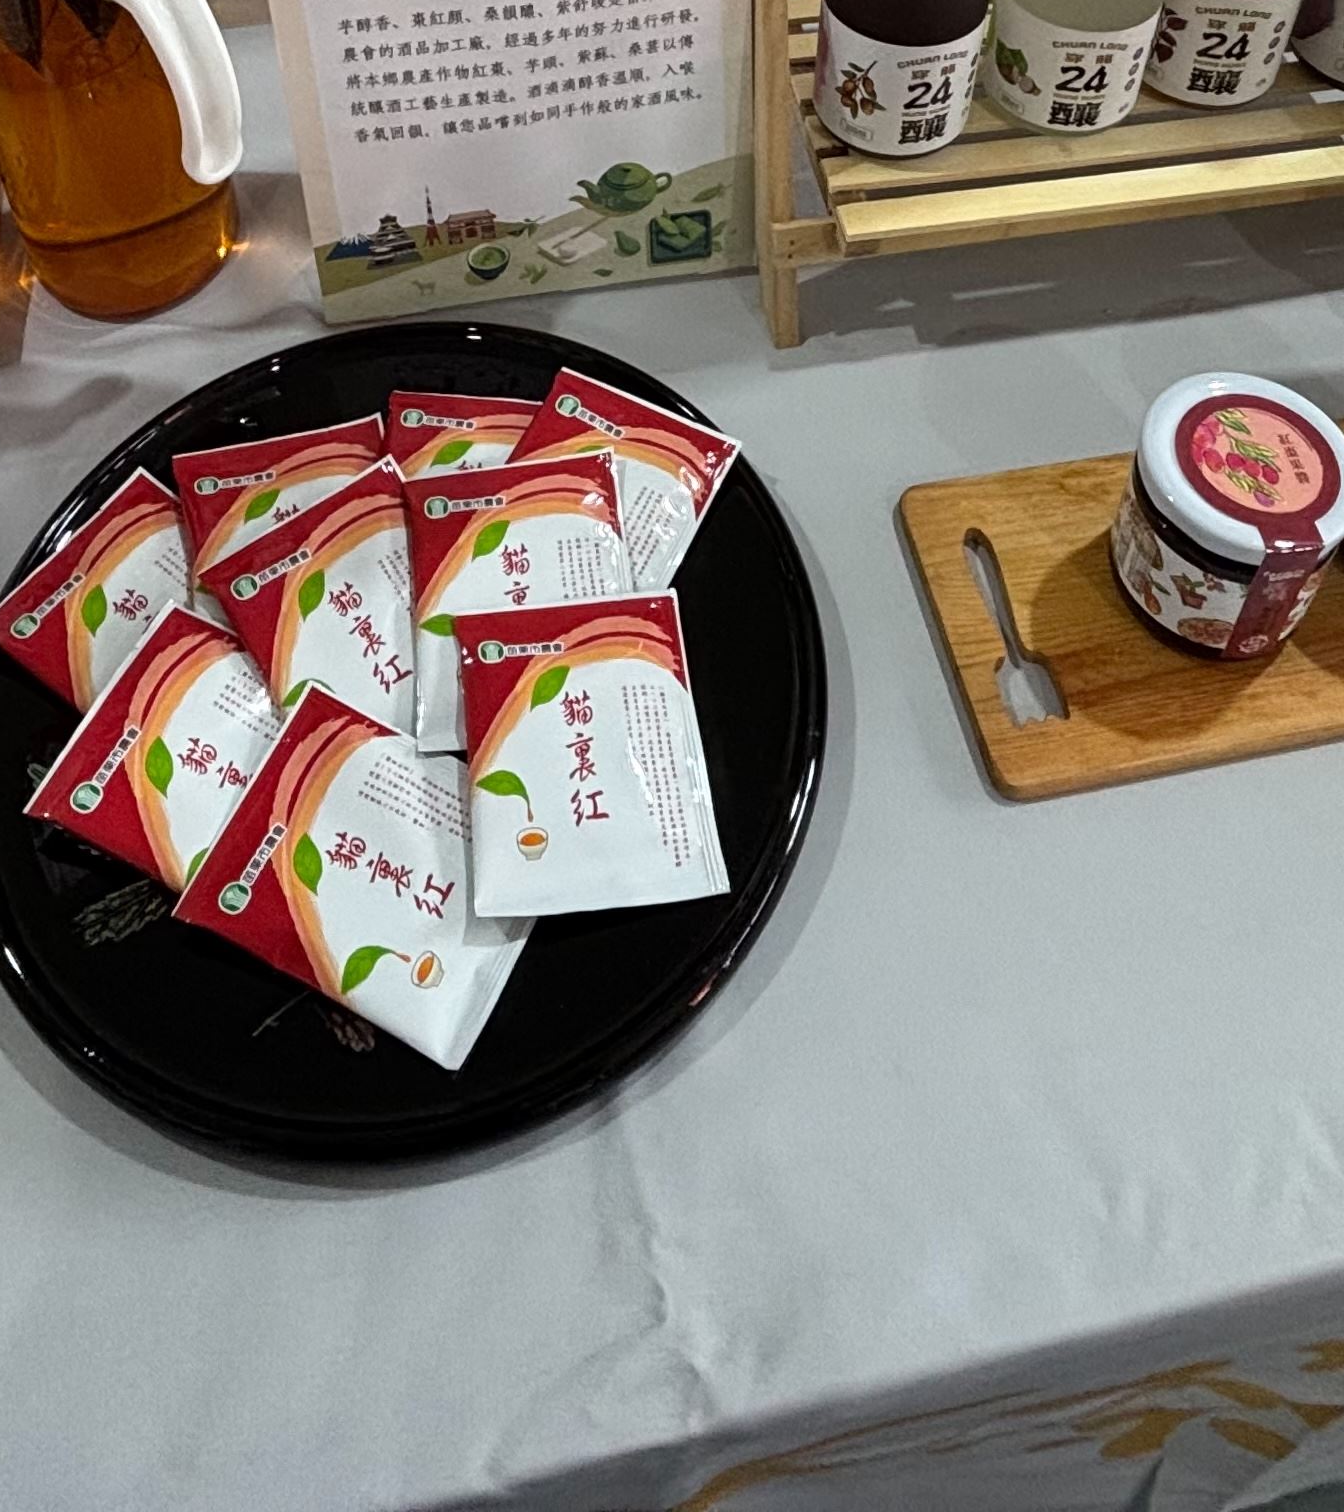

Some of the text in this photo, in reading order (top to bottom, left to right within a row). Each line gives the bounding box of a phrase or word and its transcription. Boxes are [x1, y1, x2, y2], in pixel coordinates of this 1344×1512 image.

[1196, 32, 1251, 61] 24
[903, 76, 954, 110] 24
[1054, 65, 1109, 93] 24
